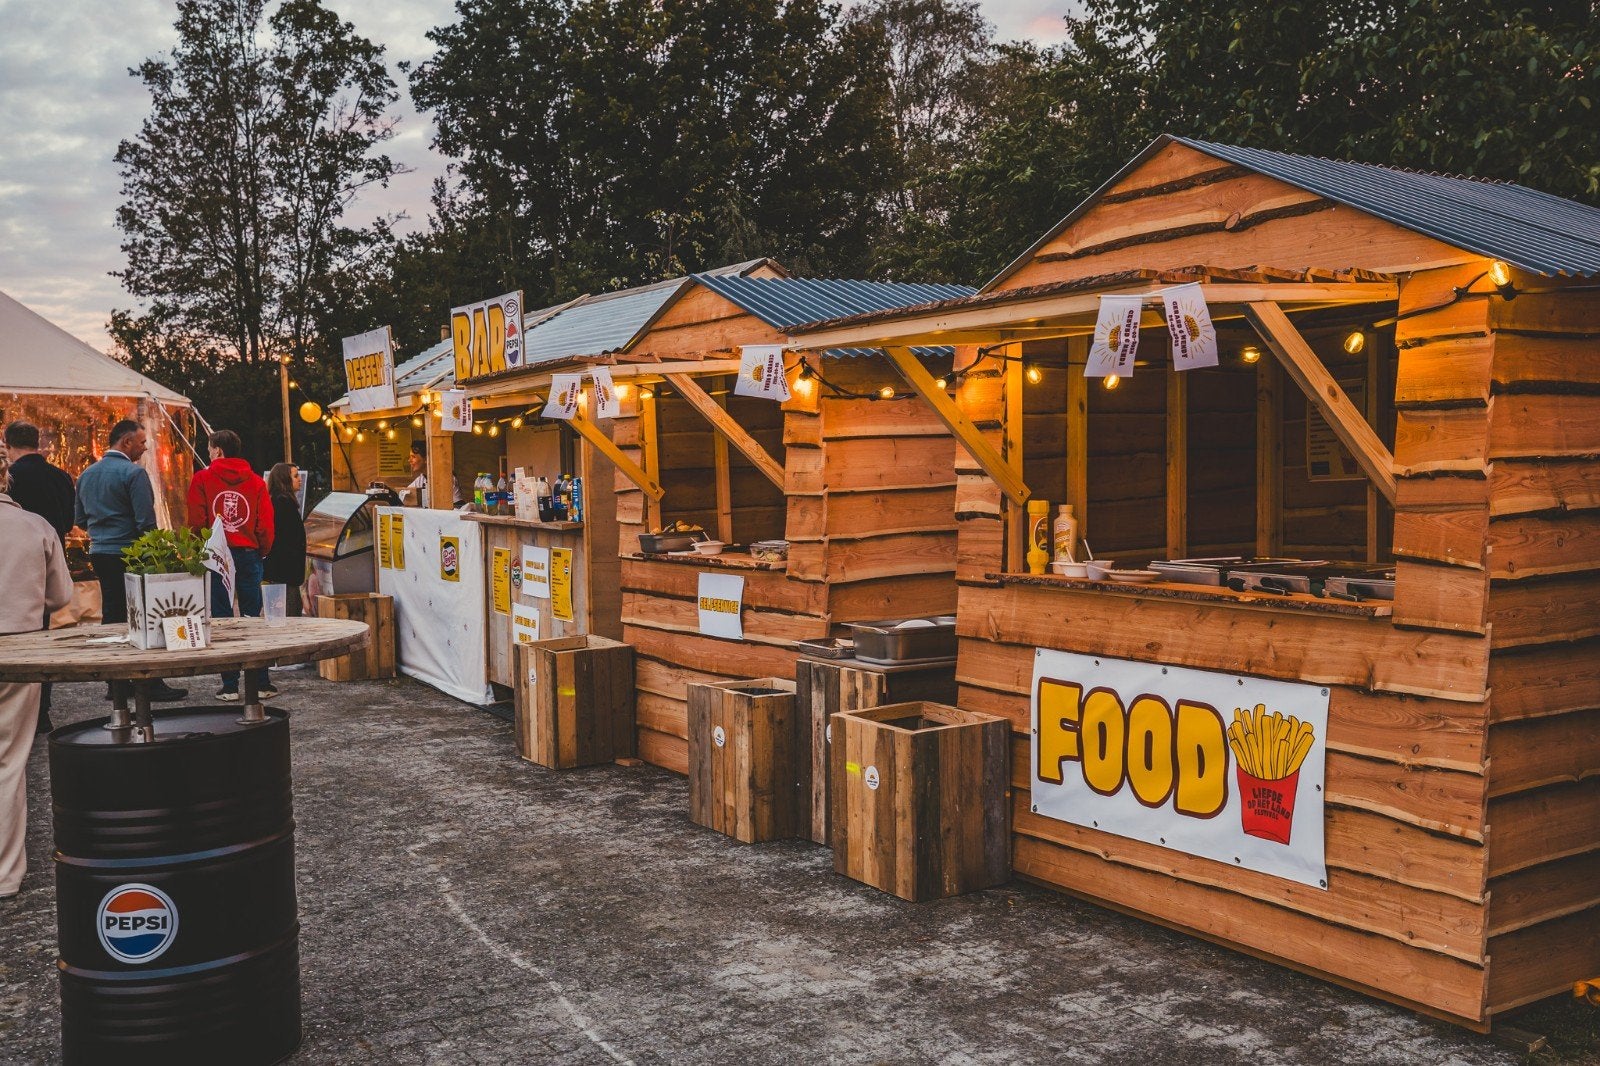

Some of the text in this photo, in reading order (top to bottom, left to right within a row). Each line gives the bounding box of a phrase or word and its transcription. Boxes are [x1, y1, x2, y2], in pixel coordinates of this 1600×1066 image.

[452, 303, 507, 381] BAR
[506, 338, 519, 350] PEPSI
[1037, 676, 1230, 820] FOOD
[1252, 787, 1283, 804] LIEFDE
[1247, 798, 1291, 819] OP HET LAND
[1254, 808, 1280, 820] FESTIVAL
[105, 915, 168, 931] PEPSI
